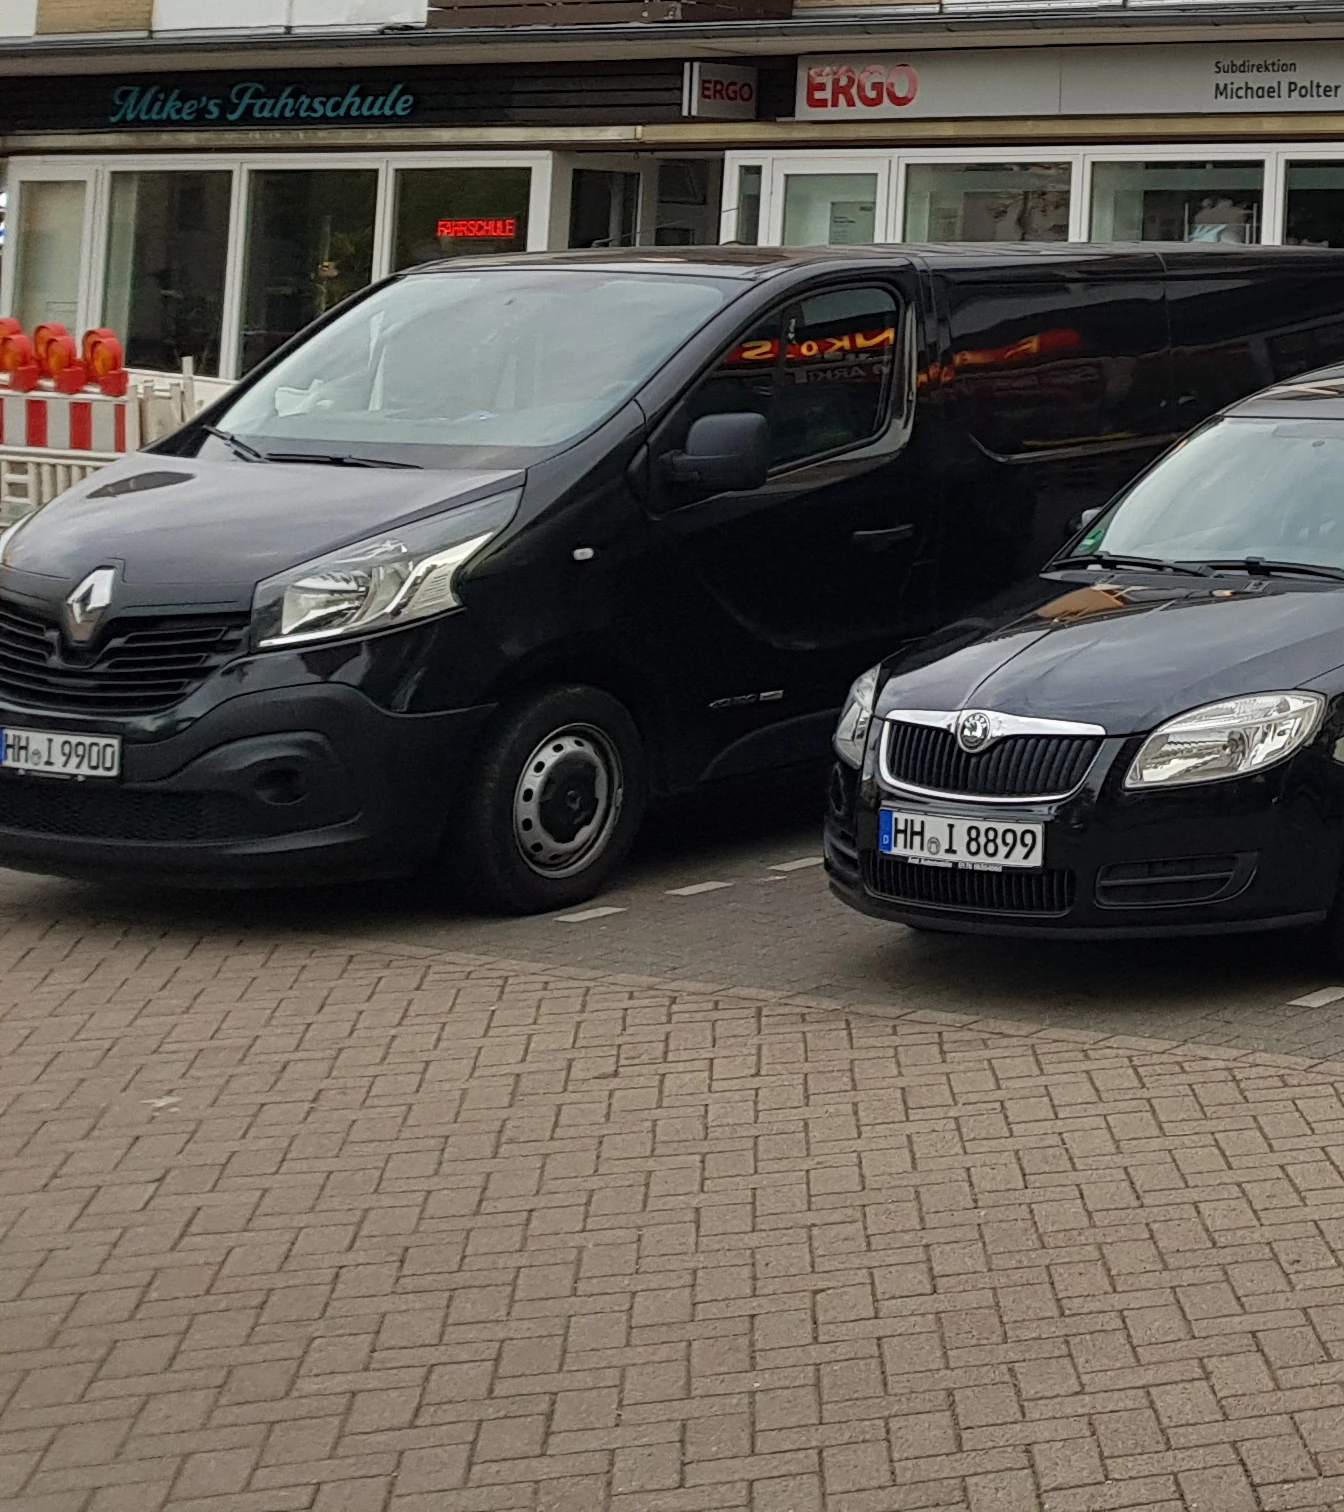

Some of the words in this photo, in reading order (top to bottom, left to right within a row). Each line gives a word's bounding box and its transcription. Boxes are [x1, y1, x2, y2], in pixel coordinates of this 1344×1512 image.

[1214, 59, 1297, 74] Subdirektion
[227, 82, 415, 121] Fahrschule
[701, 79, 753, 102] ERGO
[806, 64, 919, 108] ERGO
[1214, 81, 1282, 99] Michael
[1288, 80, 1342, 98] Polter
[437, 218, 516, 238] FAHRSCHULE
[5, 733, 30, 764] HH
[60, 740, 116, 772] 9900
[893, 817, 925, 852] HH
[965, 825, 1037, 860] 8899
